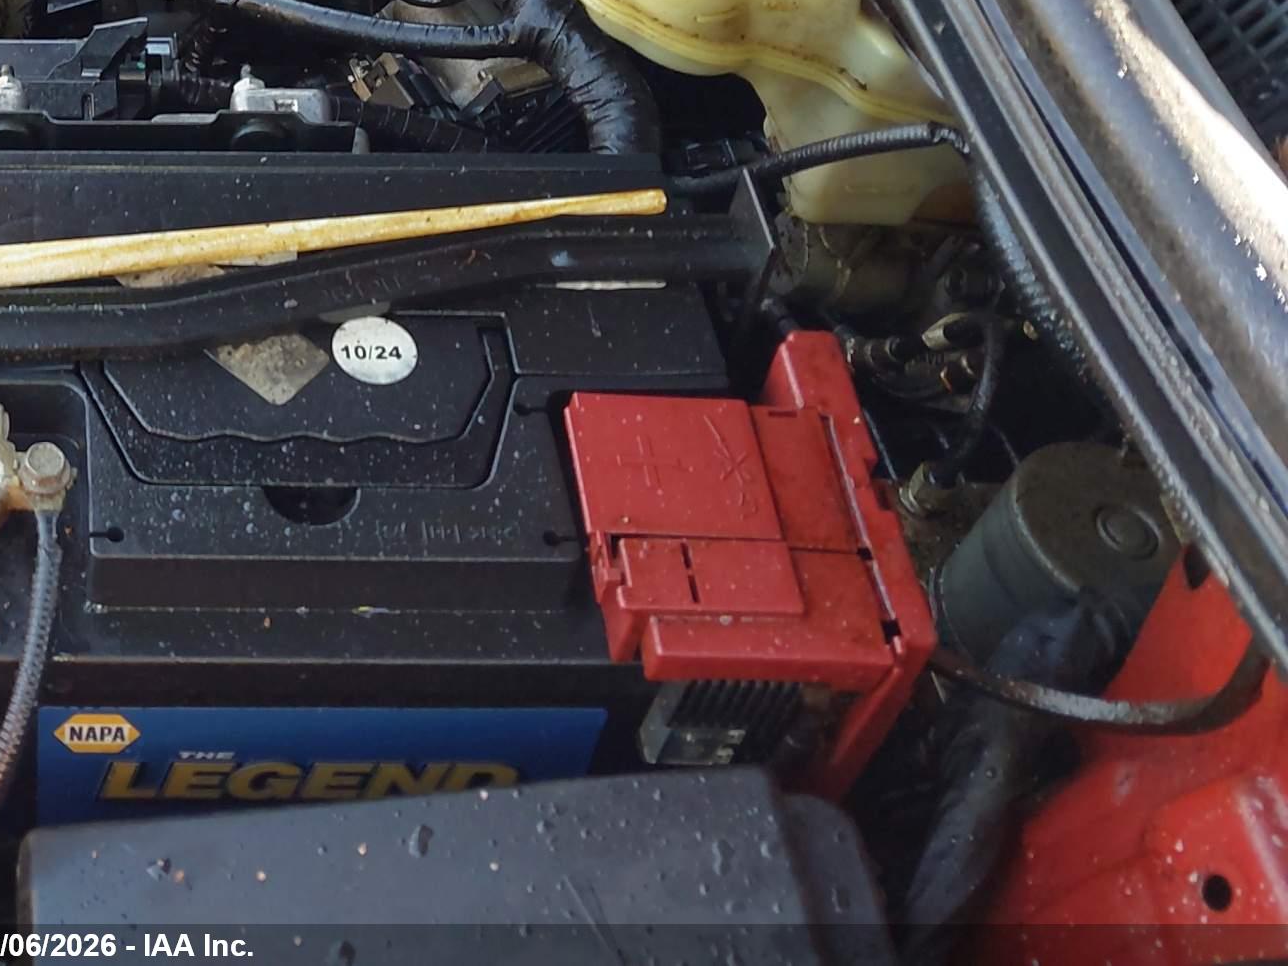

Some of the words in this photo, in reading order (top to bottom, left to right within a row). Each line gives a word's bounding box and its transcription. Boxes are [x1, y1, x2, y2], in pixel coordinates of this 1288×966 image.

[340, 345, 403, 361] 10/24
[69, 726, 126, 743] NAPA
[179, 751, 235, 760] THE
